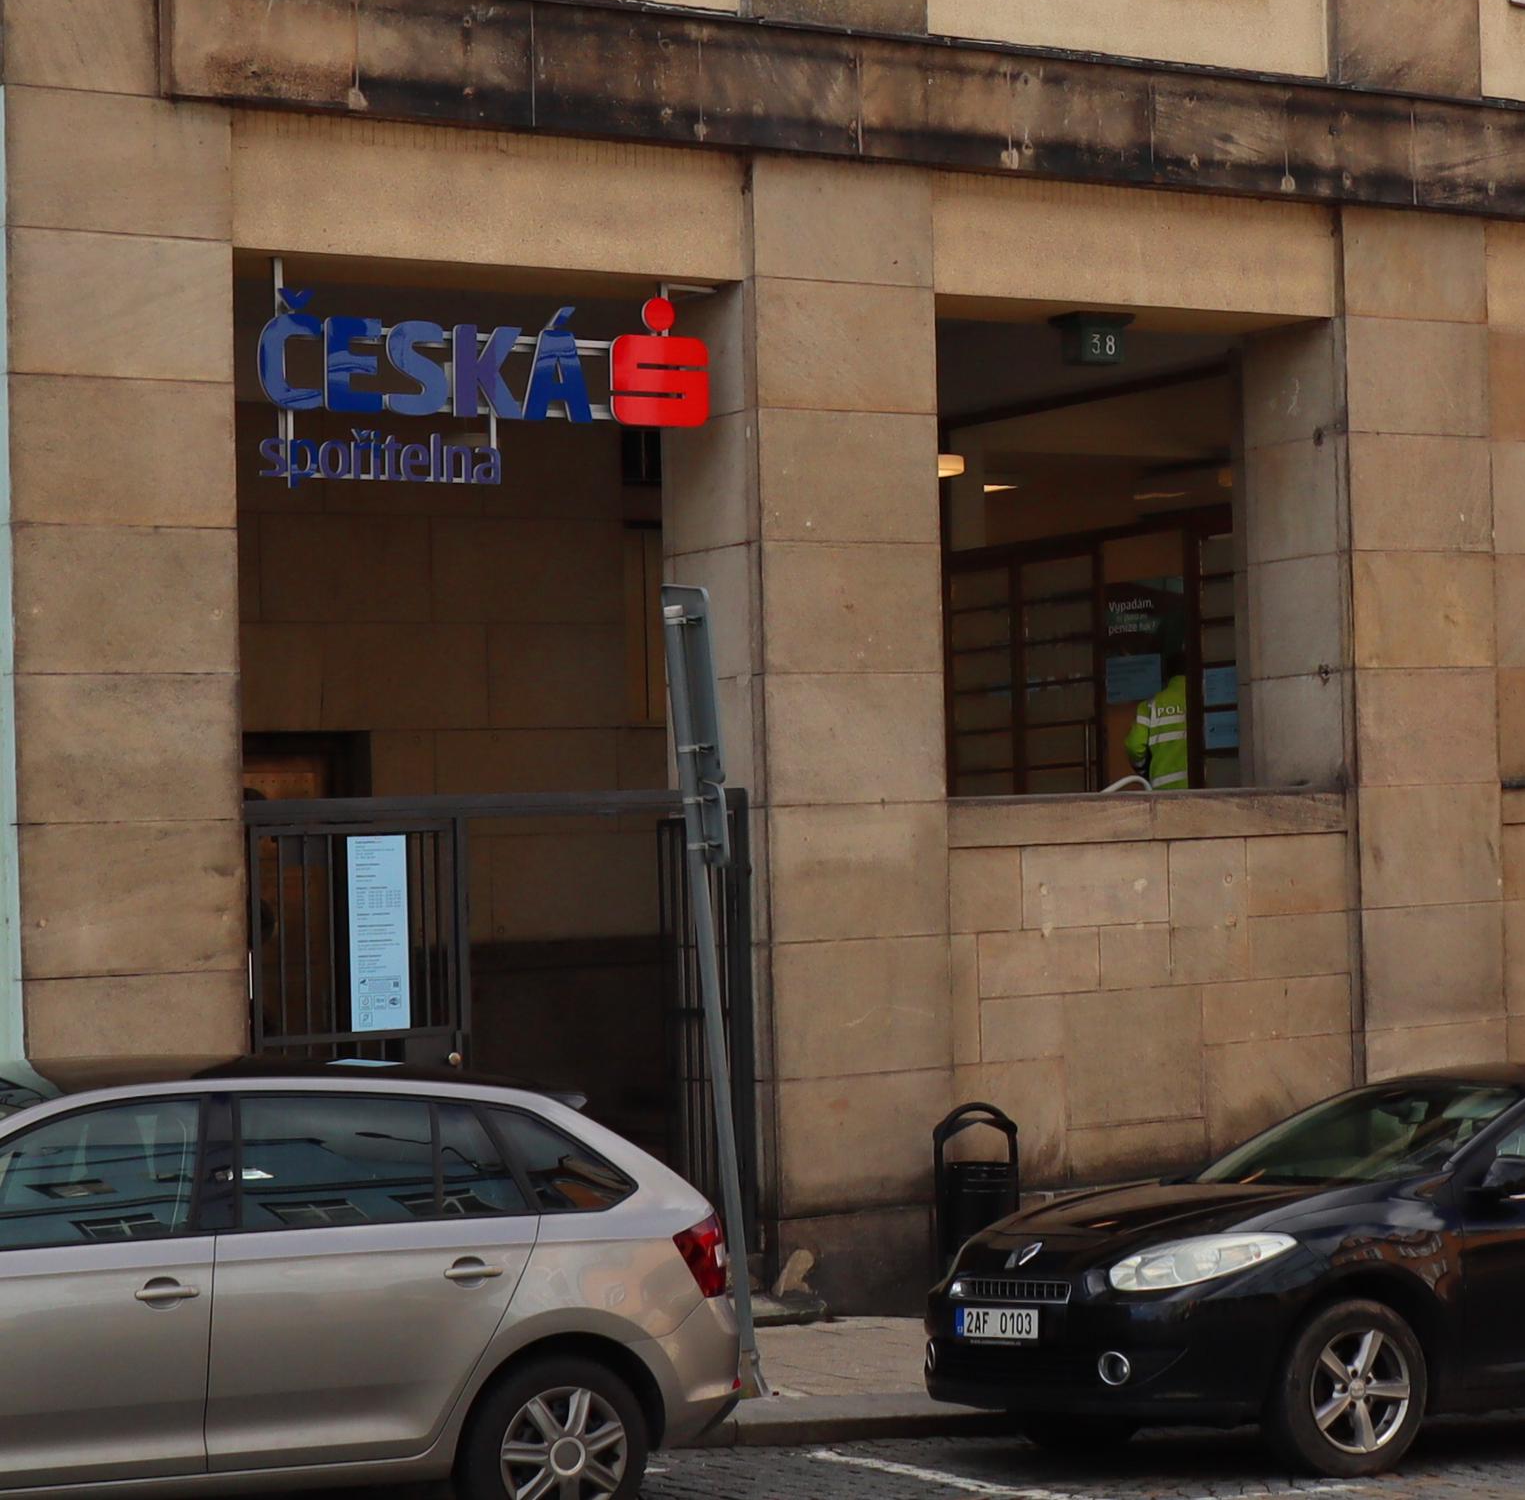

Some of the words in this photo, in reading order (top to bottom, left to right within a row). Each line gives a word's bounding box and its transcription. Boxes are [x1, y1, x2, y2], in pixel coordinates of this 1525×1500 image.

[257, 288, 593, 423] ČESKÁ
[1091, 333, 1116, 355] 38
[259, 429, 501, 488] spořitelna
[966, 1311, 990, 1334] 2AF
[1000, 1311, 1033, 1335] 0103
